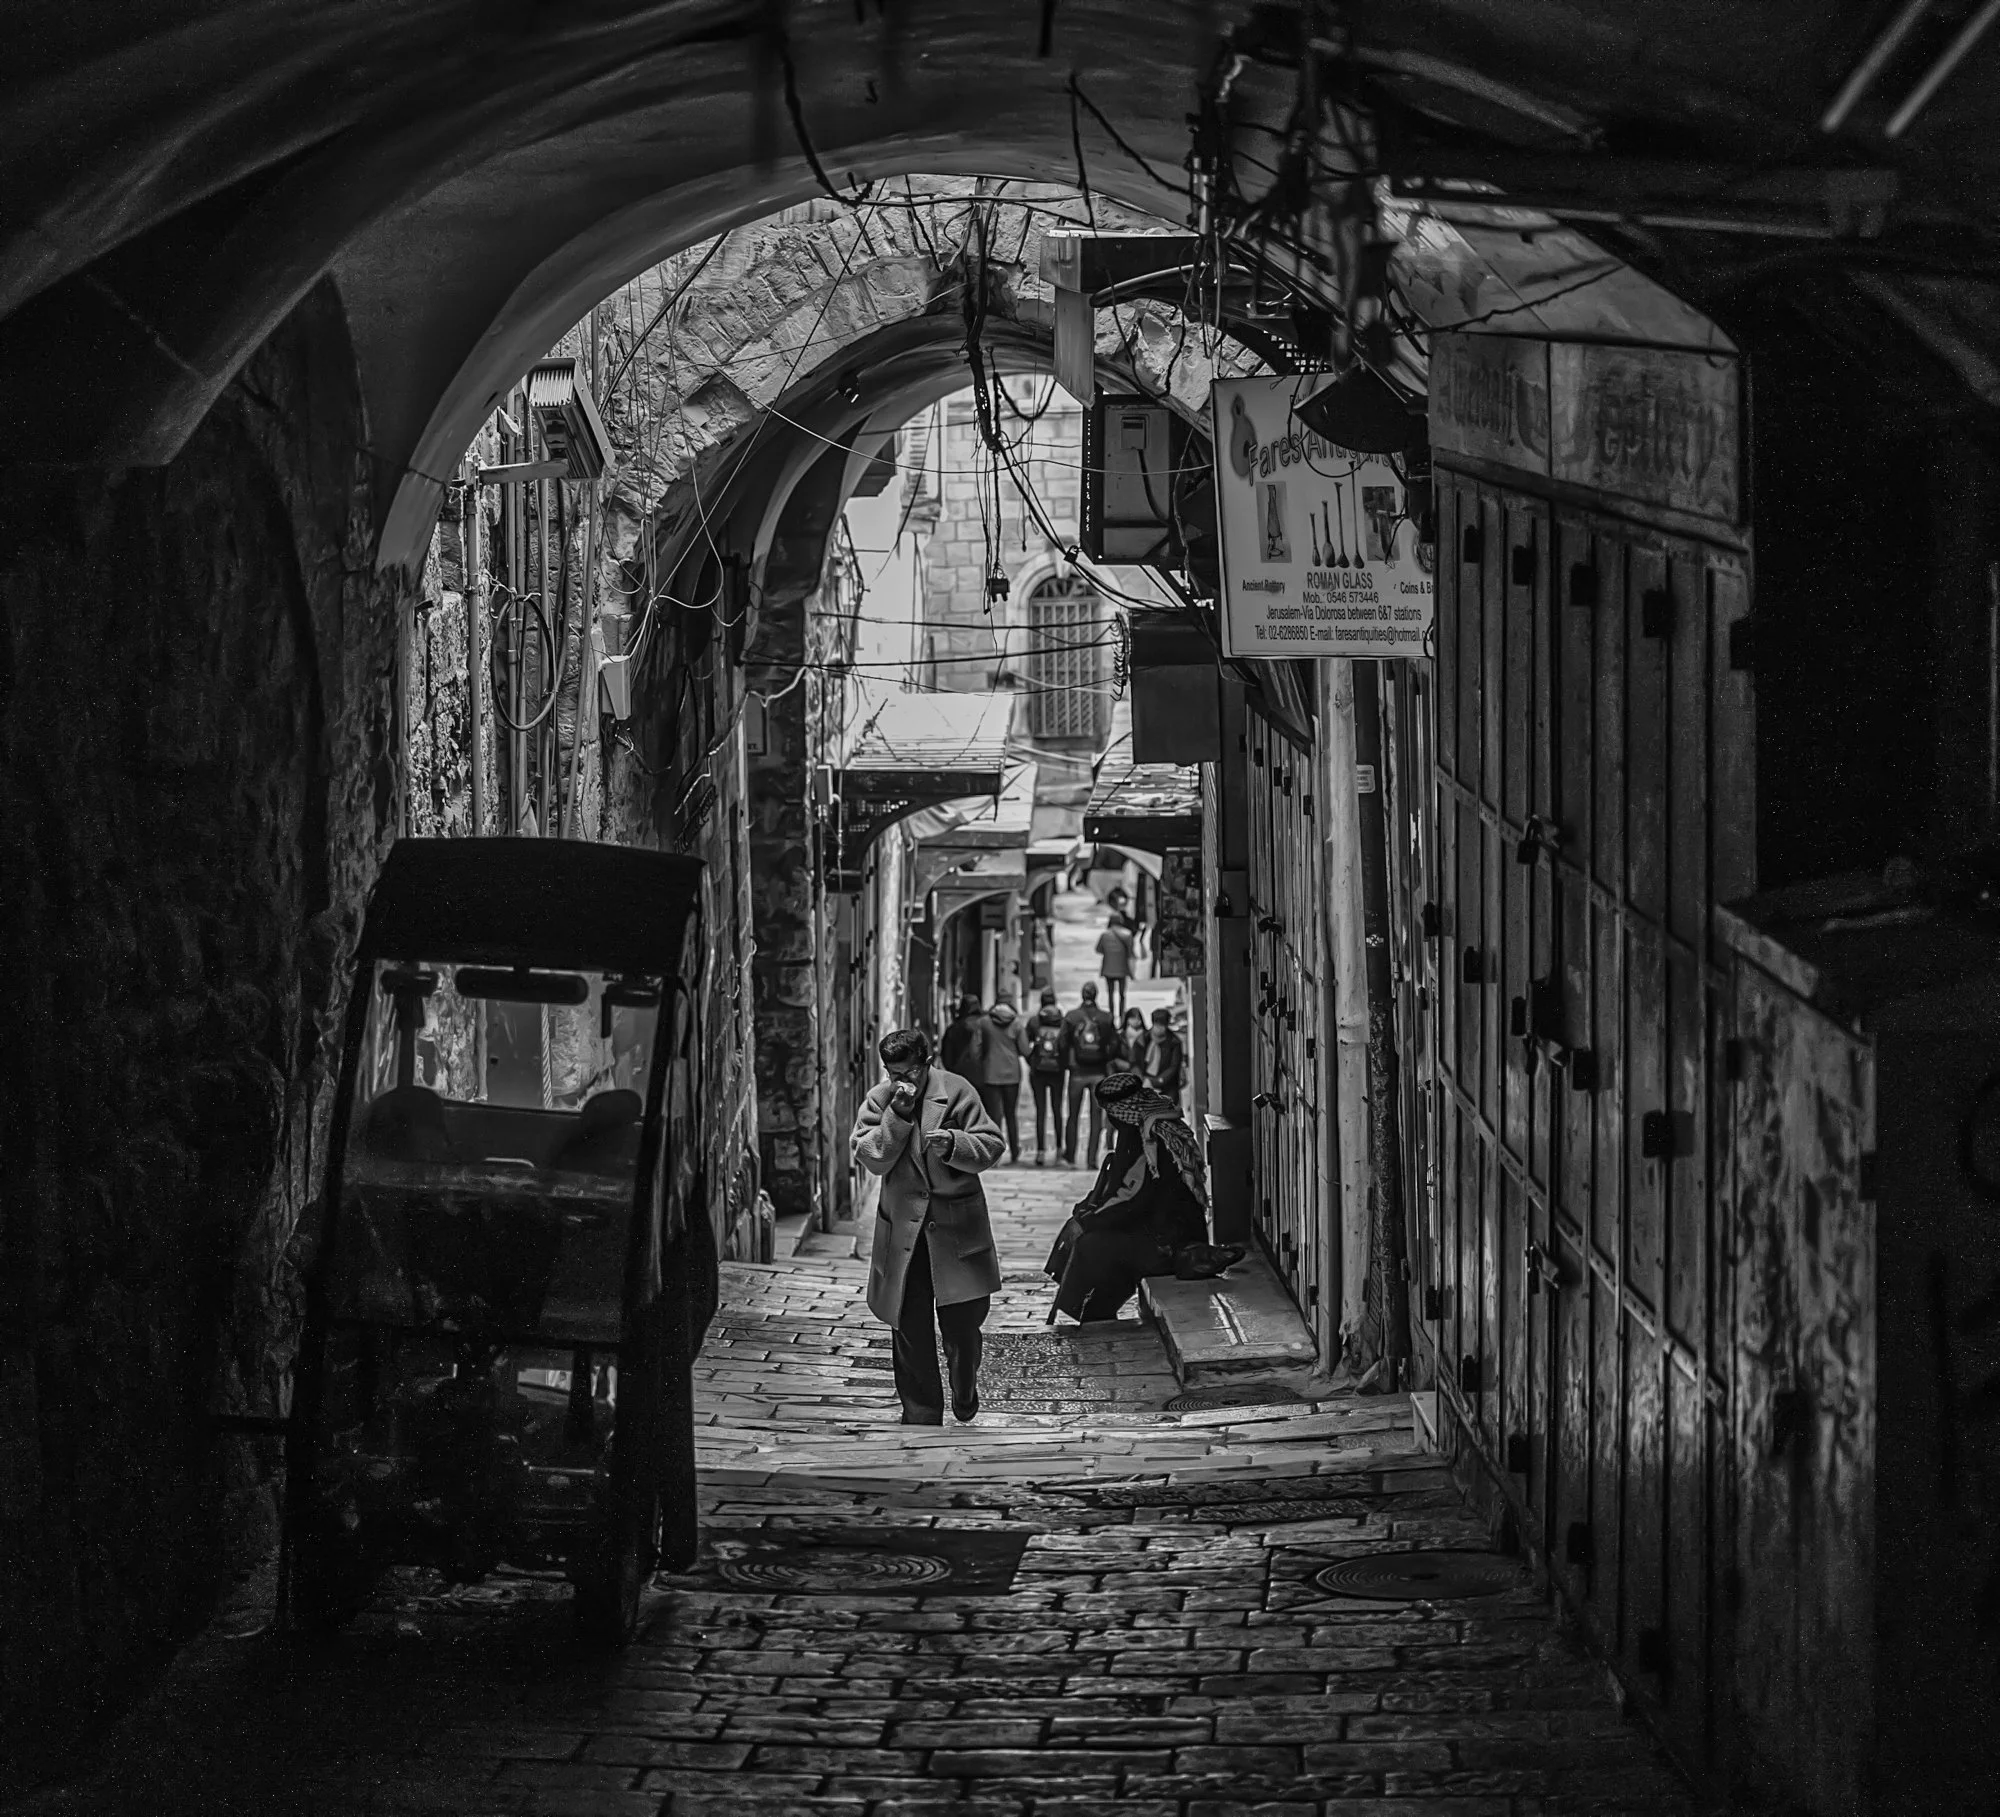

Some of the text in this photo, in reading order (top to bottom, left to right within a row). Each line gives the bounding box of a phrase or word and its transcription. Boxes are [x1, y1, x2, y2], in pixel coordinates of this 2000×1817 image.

[1249, 433, 1302, 487] Fares
[1242, 579, 1263, 591] Ancient
[1306, 572, 1373, 590] ROMAN GLASS
[1400, 580, 1419, 597] Coins
[1420, 581, 1426, 597] &
[1326, 592, 1347, 604] 0546
[1348, 592, 1379, 604] 573446
[1315, 605, 1346, 620] Dolorosa
[1347, 605, 1377, 620] between
[1378, 605, 1392, 620] 6&7
[1393, 605, 1422, 620] stations
[1254, 624, 1267, 640] Tel:
